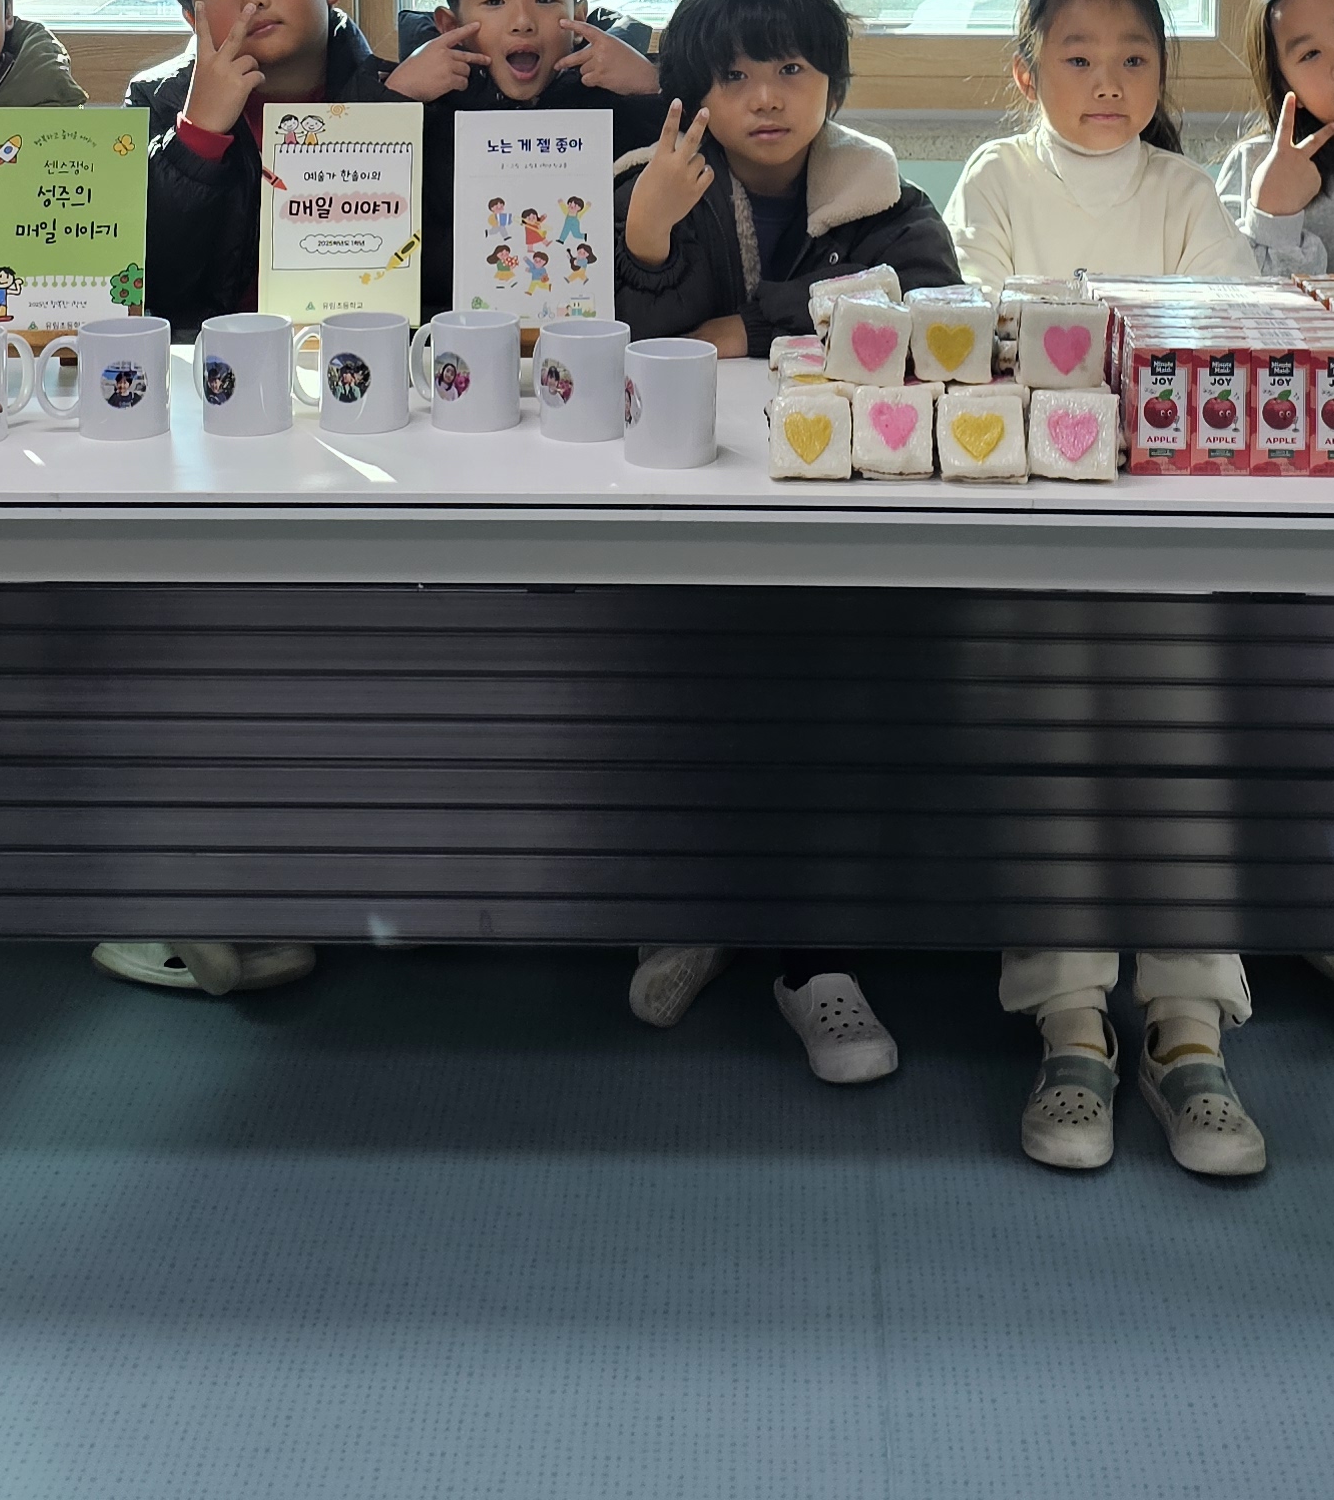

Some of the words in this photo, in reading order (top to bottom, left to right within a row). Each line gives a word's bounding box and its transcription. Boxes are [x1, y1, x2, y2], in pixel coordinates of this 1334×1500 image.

[487, 138, 513, 154] 노는
[517, 138, 532, 152] 게
[555, 137, 584, 154] 좋아
[44, 160, 94, 176] 센스쟁이
[303, 170, 336, 183] 예술가
[340, 169, 382, 183] 한솔이의
[37, 184, 92, 208] 성주의
[288, 196, 333, 219] 매일
[341, 199, 400, 215] 이야기
[16, 219, 57, 244] 매일
[64, 220, 118, 240] 이야기
[45, 321, 86, 330] 유림초등학
[1152, 377, 1174, 386] JOY
[1210, 378, 1232, 387] JOY
[1270, 378, 1292, 387] JOY
[1147, 436, 1178, 444] APPLE
[1206, 436, 1237, 444] APPLE
[1266, 437, 1297, 445] APPLE
